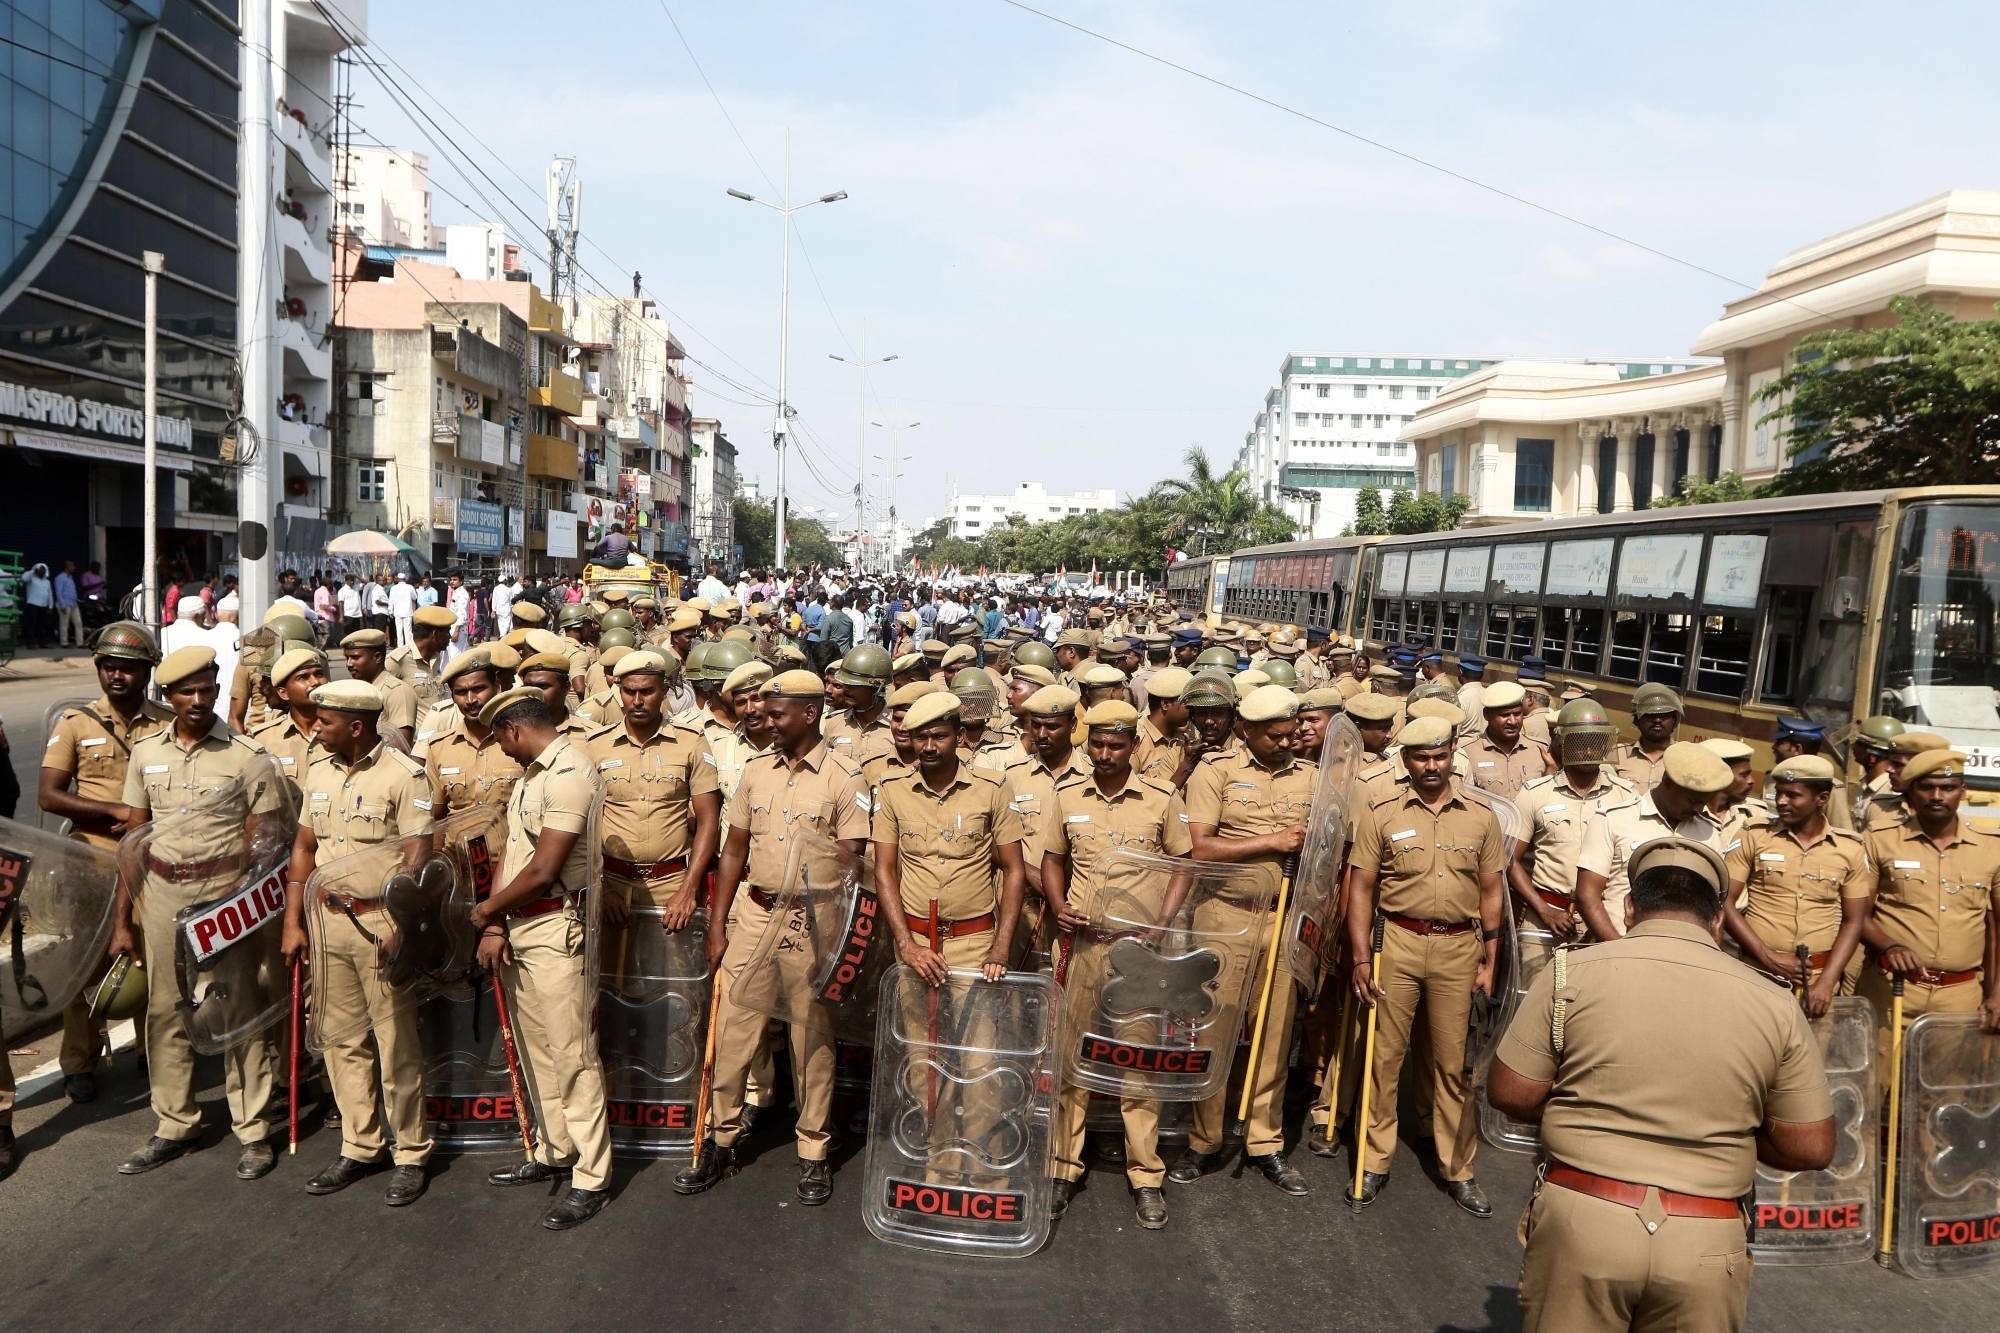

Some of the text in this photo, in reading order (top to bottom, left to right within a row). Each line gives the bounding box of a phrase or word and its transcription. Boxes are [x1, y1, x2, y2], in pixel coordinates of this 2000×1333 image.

[78, 398, 144, 439] SPORTS
[460, 510, 479, 525] SIDDU
[480, 512, 502, 528] SPORTS
[824, 897, 877, 1001] POLICE
[1090, 1040, 1205, 1072] POLICE
[425, 1096, 514, 1120] OLICE
[895, 1184, 1016, 1220] POLICE
[1757, 1202, 1860, 1229] POLICE
